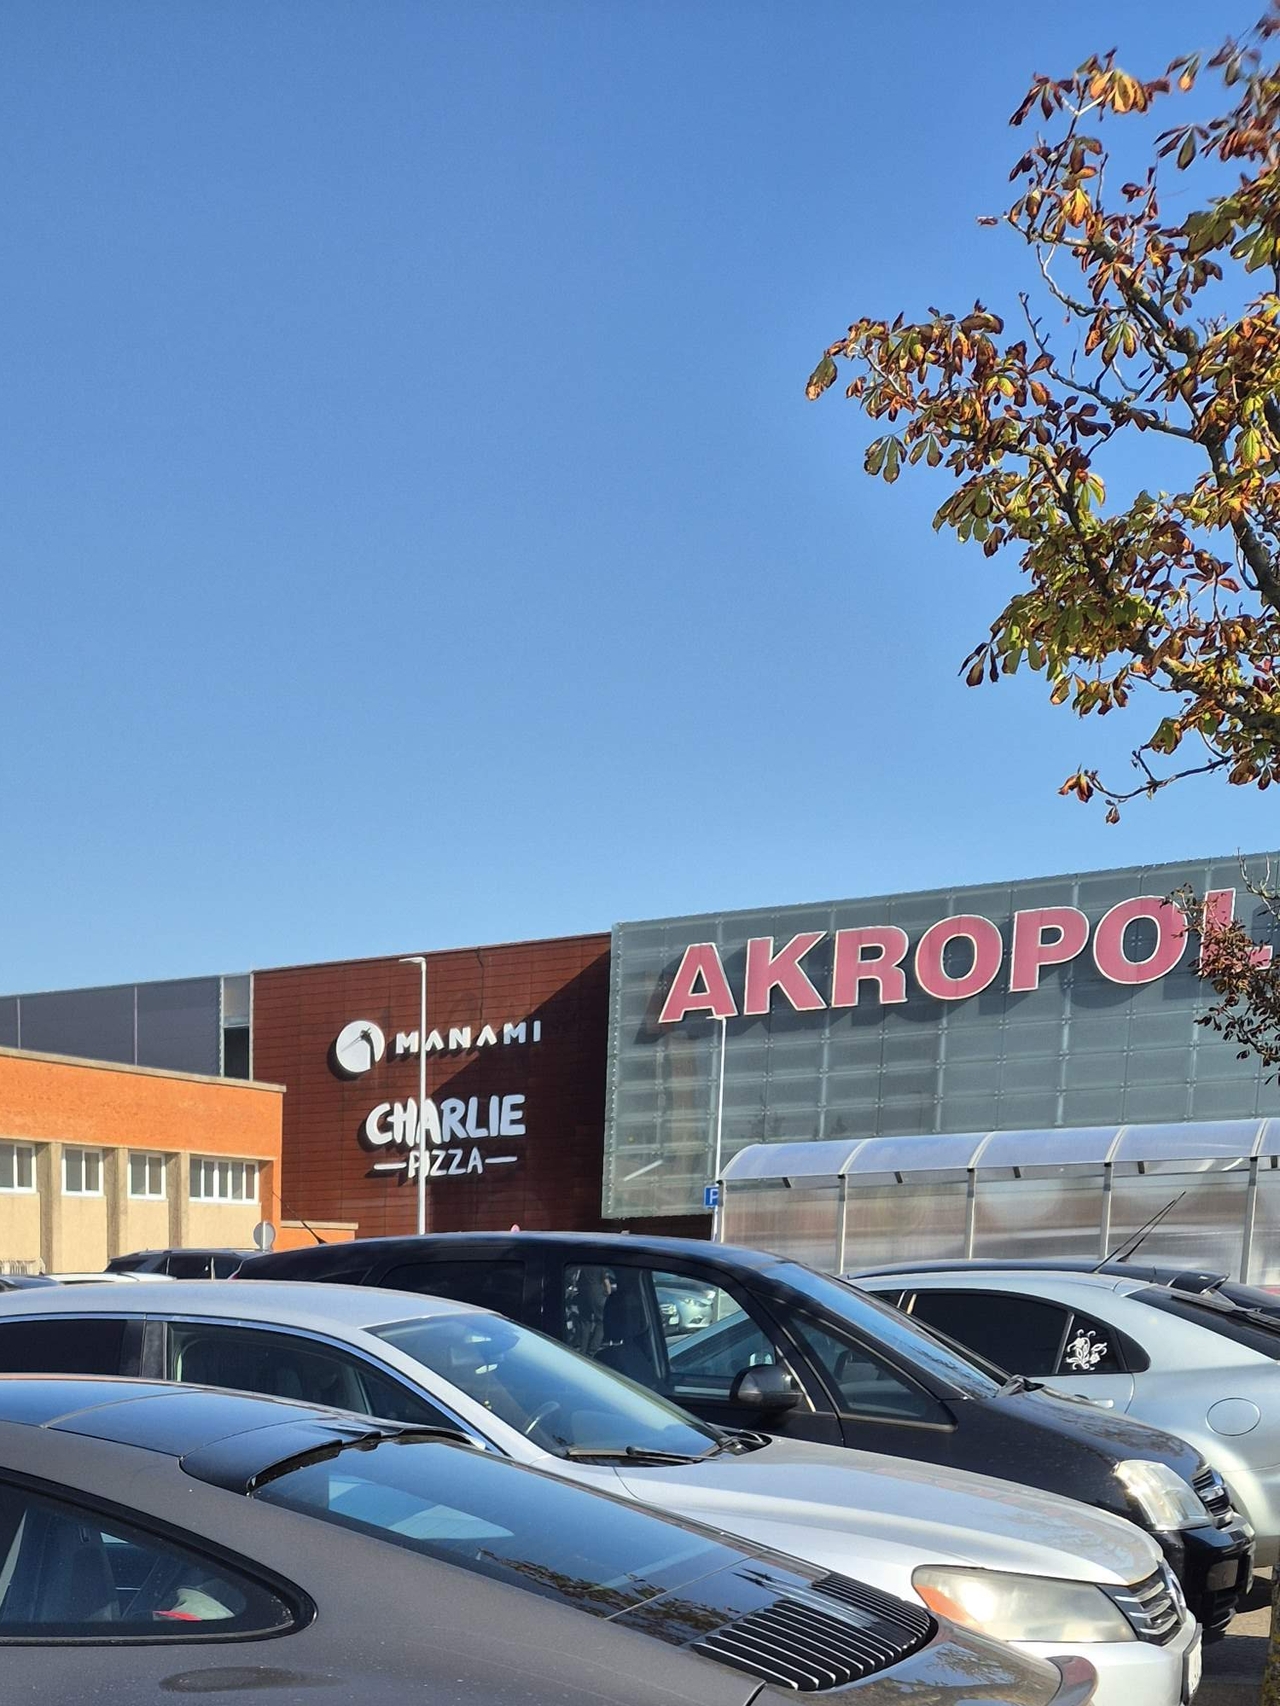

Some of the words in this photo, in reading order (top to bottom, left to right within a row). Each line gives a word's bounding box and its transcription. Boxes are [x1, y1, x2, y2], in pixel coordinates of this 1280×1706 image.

[395, 1020, 542, 1055] MANAMI
[365, 1094, 527, 1147] CHARLIE
[709, 1188, 719, 1205] P
